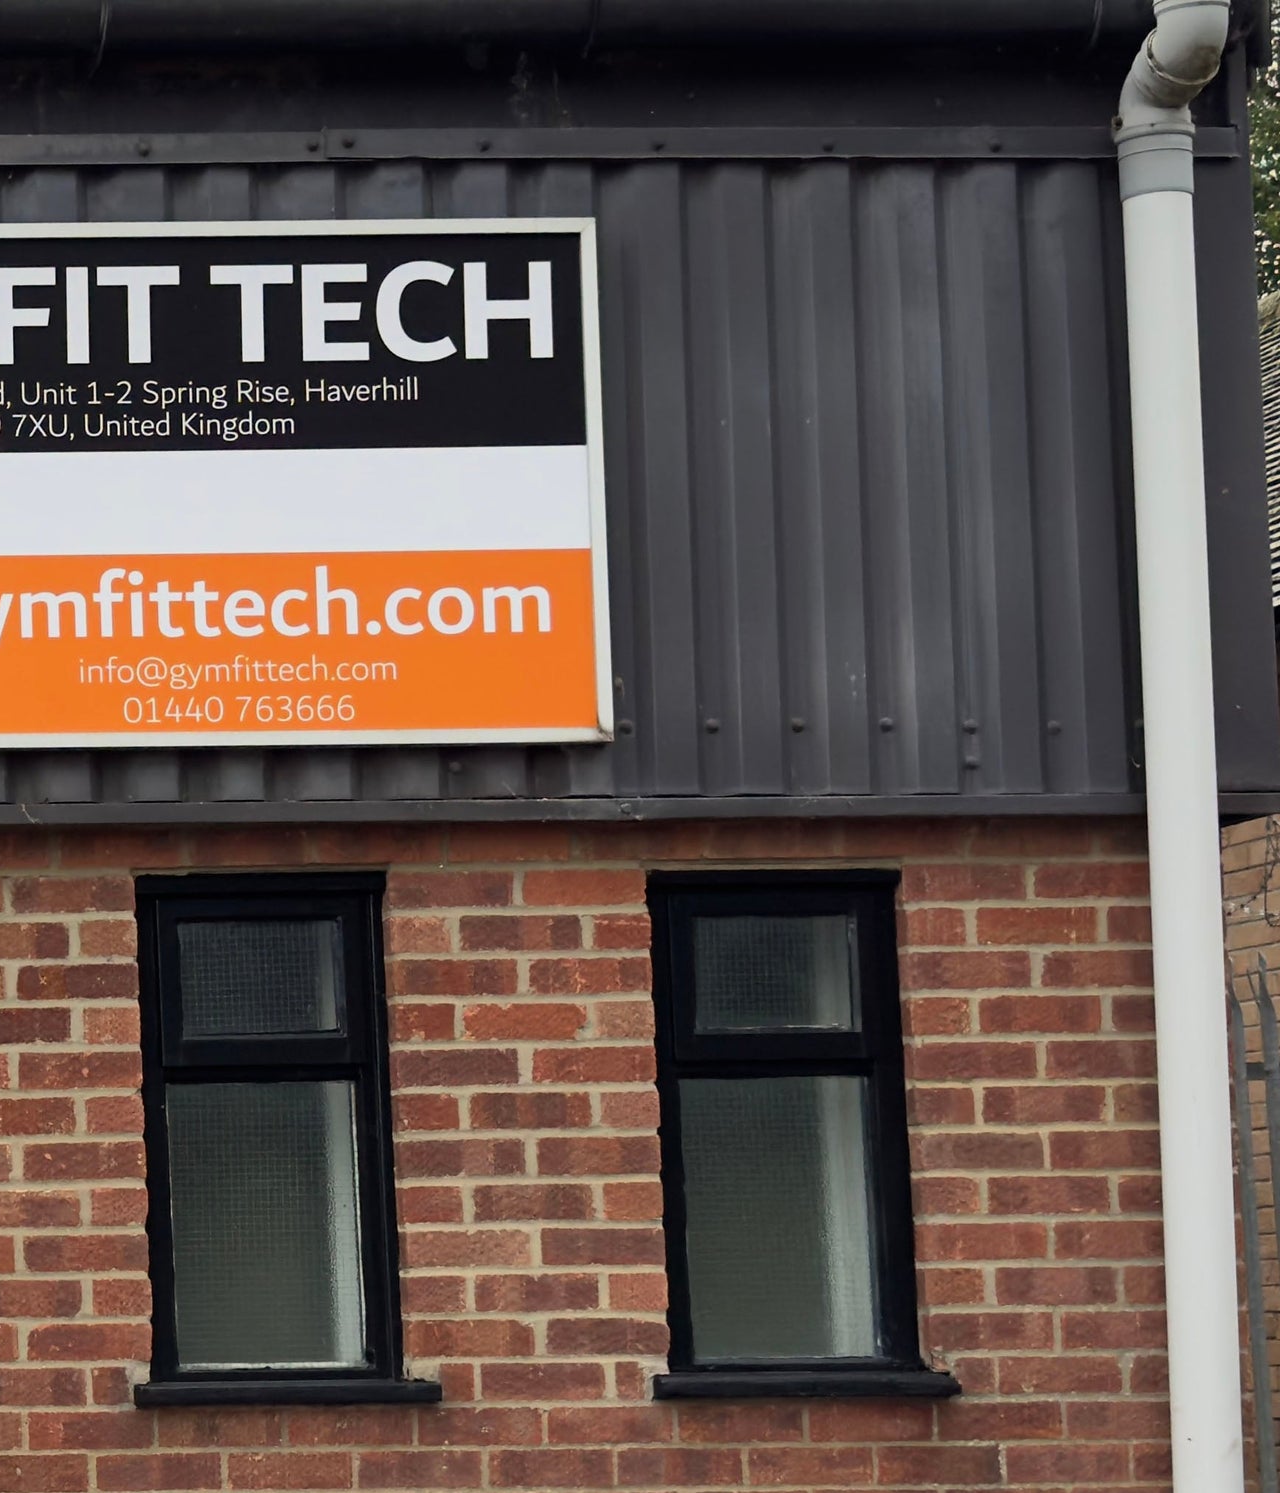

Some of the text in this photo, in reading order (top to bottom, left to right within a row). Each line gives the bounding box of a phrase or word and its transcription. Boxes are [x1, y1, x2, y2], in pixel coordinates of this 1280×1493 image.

[209, 260, 554, 363] TECH
[21, 381, 78, 406] Unit
[87, 380, 133, 405] 1-2
[142, 380, 228, 410] Spring
[237, 379, 295, 406] Rise,
[305, 375, 418, 402] Haverhill
[11, 413, 75, 441] 7XU,
[84, 411, 170, 437] United
[181, 410, 295, 442] Kingdom
[79, 654, 398, 690] info@gymfittech.com
[123, 694, 355, 724] 01440 763666
